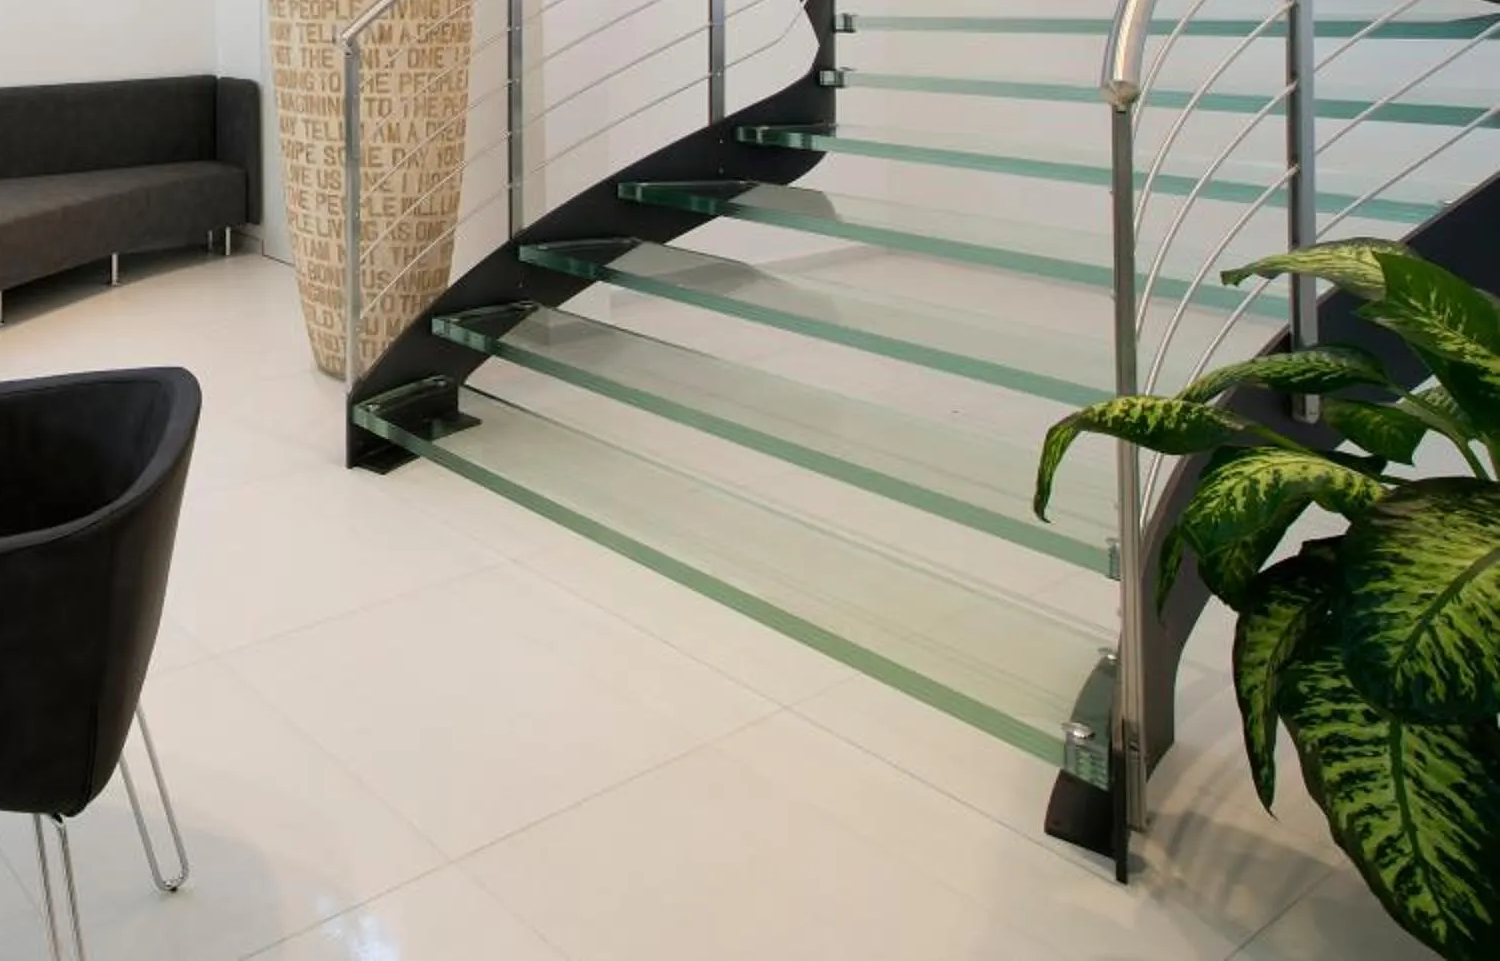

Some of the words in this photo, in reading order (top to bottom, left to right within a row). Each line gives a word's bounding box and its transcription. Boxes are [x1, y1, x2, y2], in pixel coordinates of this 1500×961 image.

[289, 0, 362, 21] PEOPLE
[301, 48, 334, 68] THE
[407, 47, 445, 68] ONE
[319, 71, 341, 92] TO
[364, 97, 393, 118] TO
[407, 121, 418, 143] A
